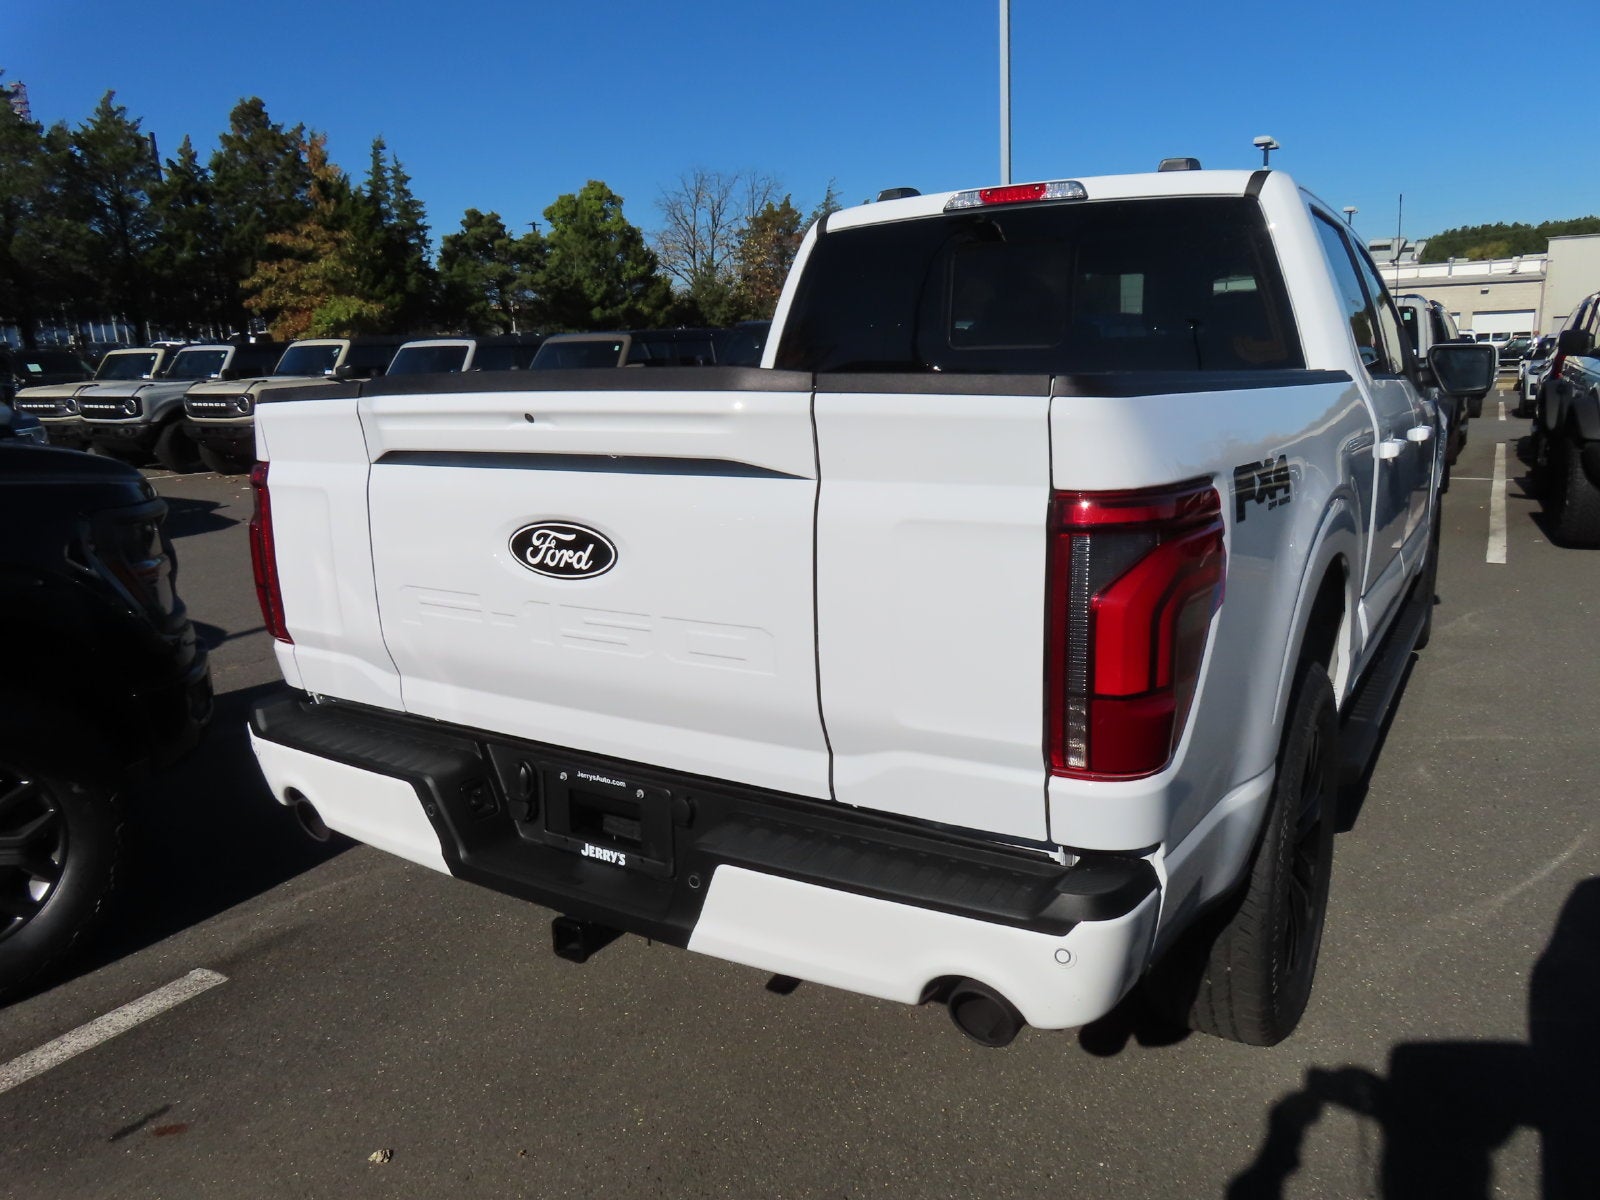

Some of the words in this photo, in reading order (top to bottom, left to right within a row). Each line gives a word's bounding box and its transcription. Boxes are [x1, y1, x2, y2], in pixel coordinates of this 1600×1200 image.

[1233, 454, 1290, 524] FX4
[525, 528, 595, 571] Ford
[576, 770, 627, 788] JerrysAuto.com
[580, 843, 627, 866] JERRY'S
